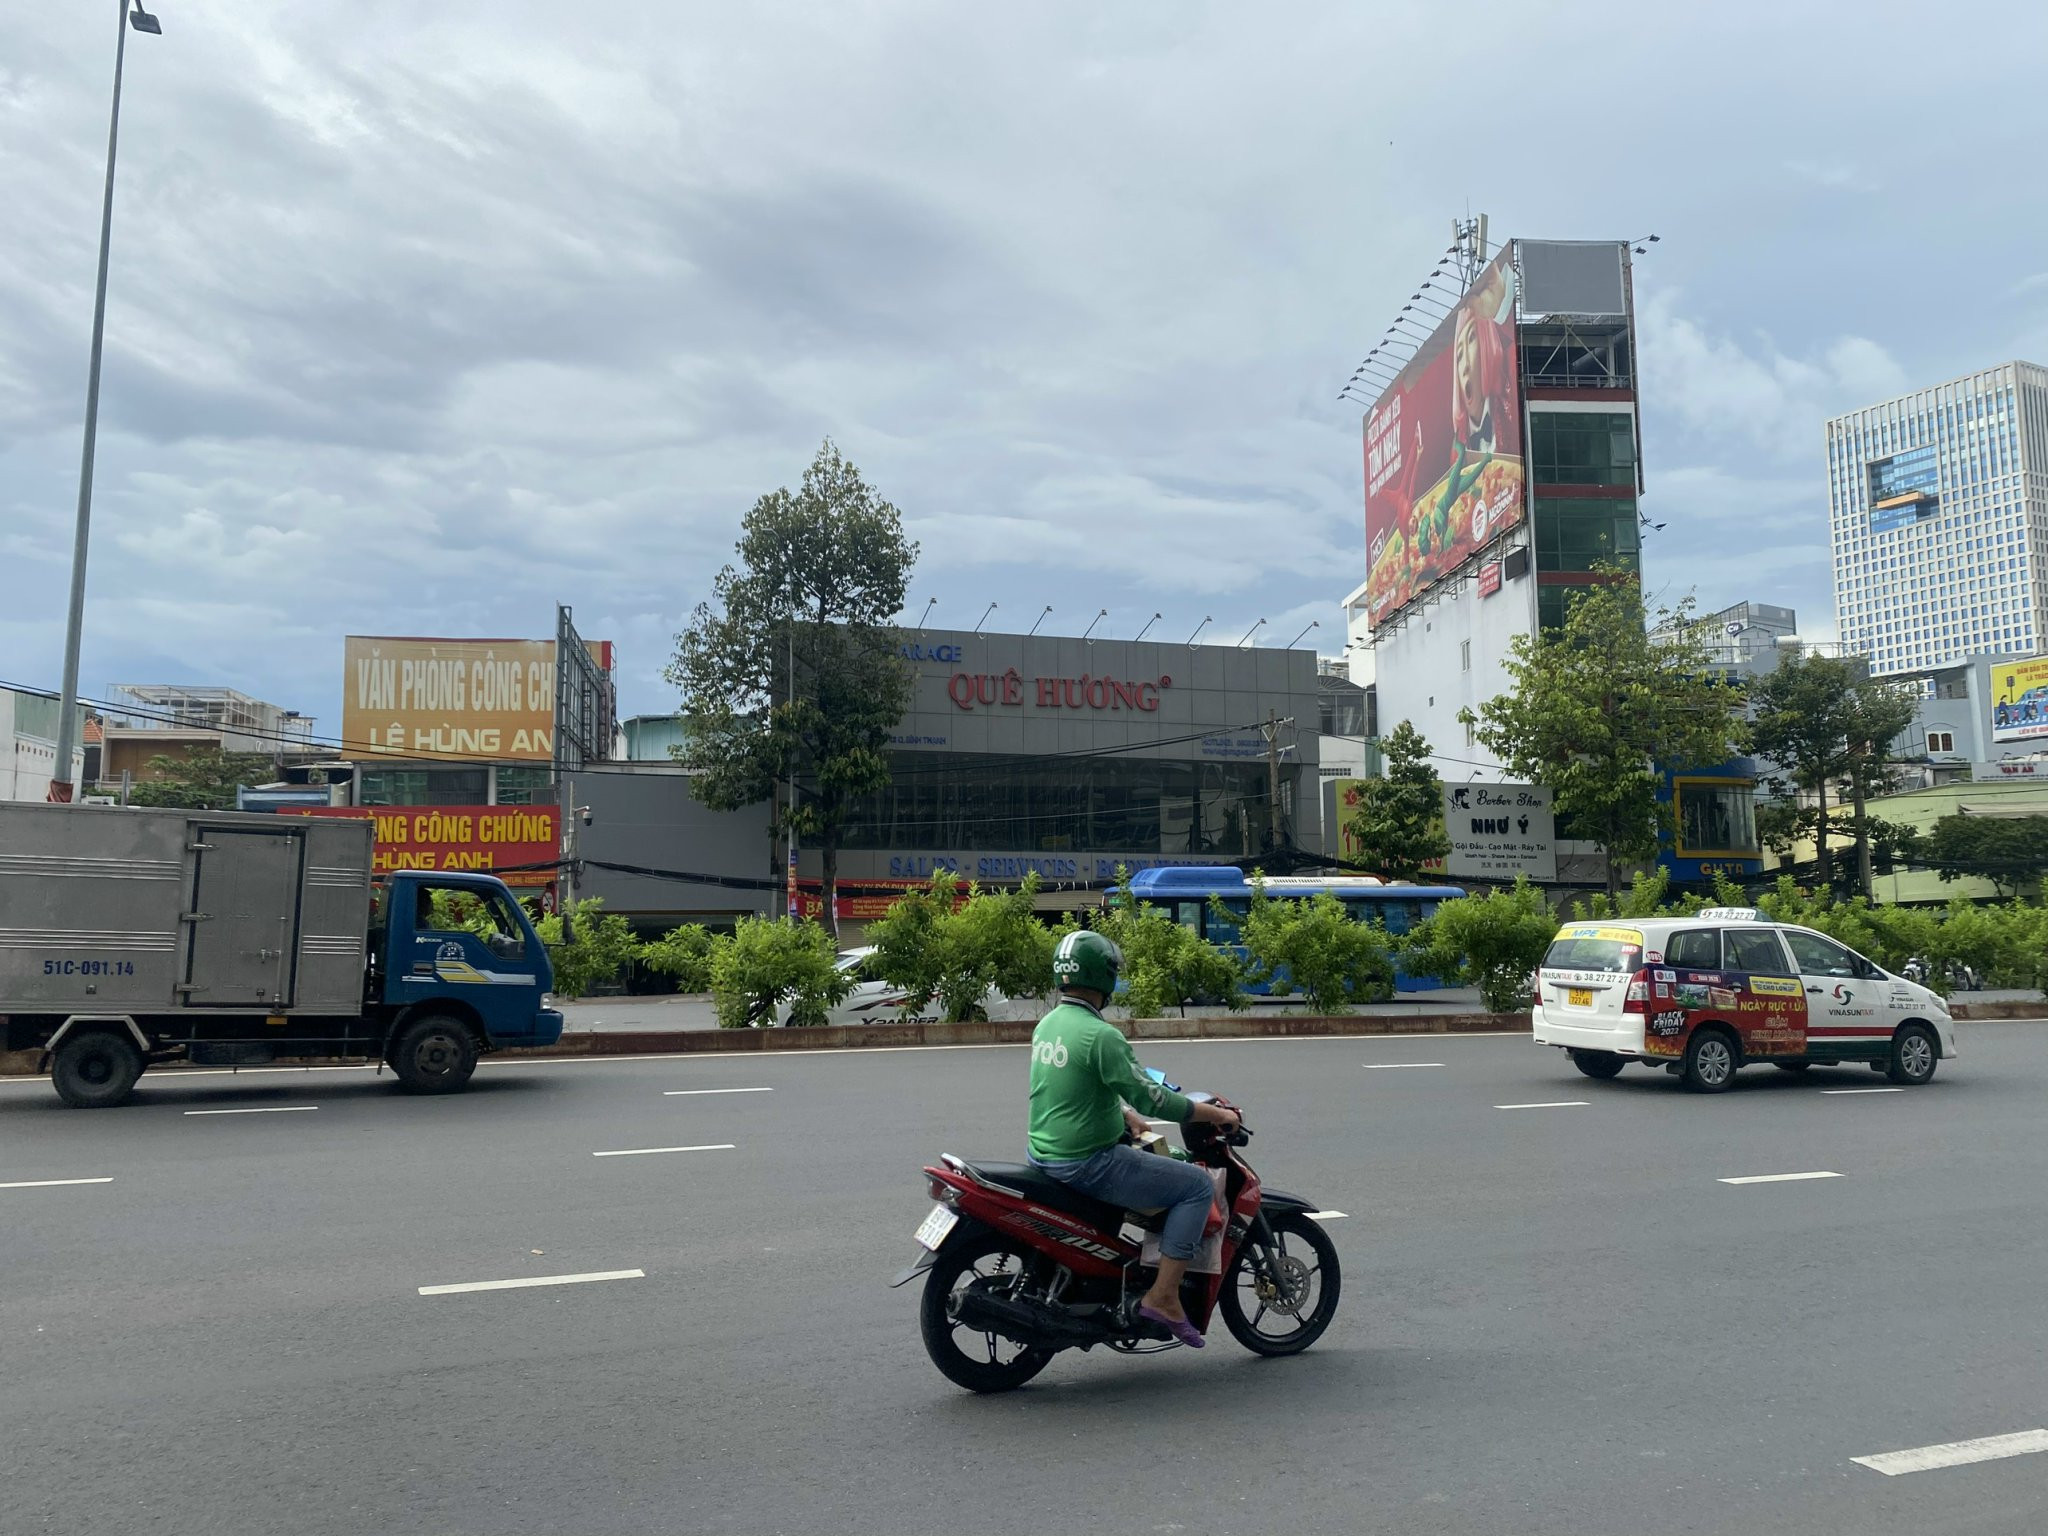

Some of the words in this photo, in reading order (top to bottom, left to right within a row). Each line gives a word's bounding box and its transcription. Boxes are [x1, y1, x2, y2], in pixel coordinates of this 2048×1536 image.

[895, 644, 962, 663] ARAGE
[357, 648, 396, 710] VĂN
[401, 647, 466, 711] PHÒNG
[471, 650, 522, 712] CÔNG
[948, 667, 1023, 710] QUÊ
[1035, 674, 1160, 712] HƯƠNG
[370, 722, 405, 752] LÊ
[415, 723, 500, 752] HÙNG
[510, 728, 553, 752] AN
[1476, 789, 1512, 806] Barber
[414, 811, 472, 844] CÔNG
[479, 810, 552, 843] CHỨNG
[1471, 816, 1510, 834] NHƯ
[1517, 814, 1529, 834] Ý
[372, 847, 435, 870] HÙNG
[442, 851, 493, 869] ANH
[977, 857, 1076, 879] SERVICES
[44, 960, 134, 976] 51C-091.14
[1054, 961, 1079, 973] Grab
[1664, 972, 1674, 980] LG
[1740, 999, 1766, 1011] NGÀY
[1653, 1018, 1685, 1029] FRIDAY
[1658, 1010, 1683, 1021] BLACK
[1660, 1027, 1679, 1036] 2022
